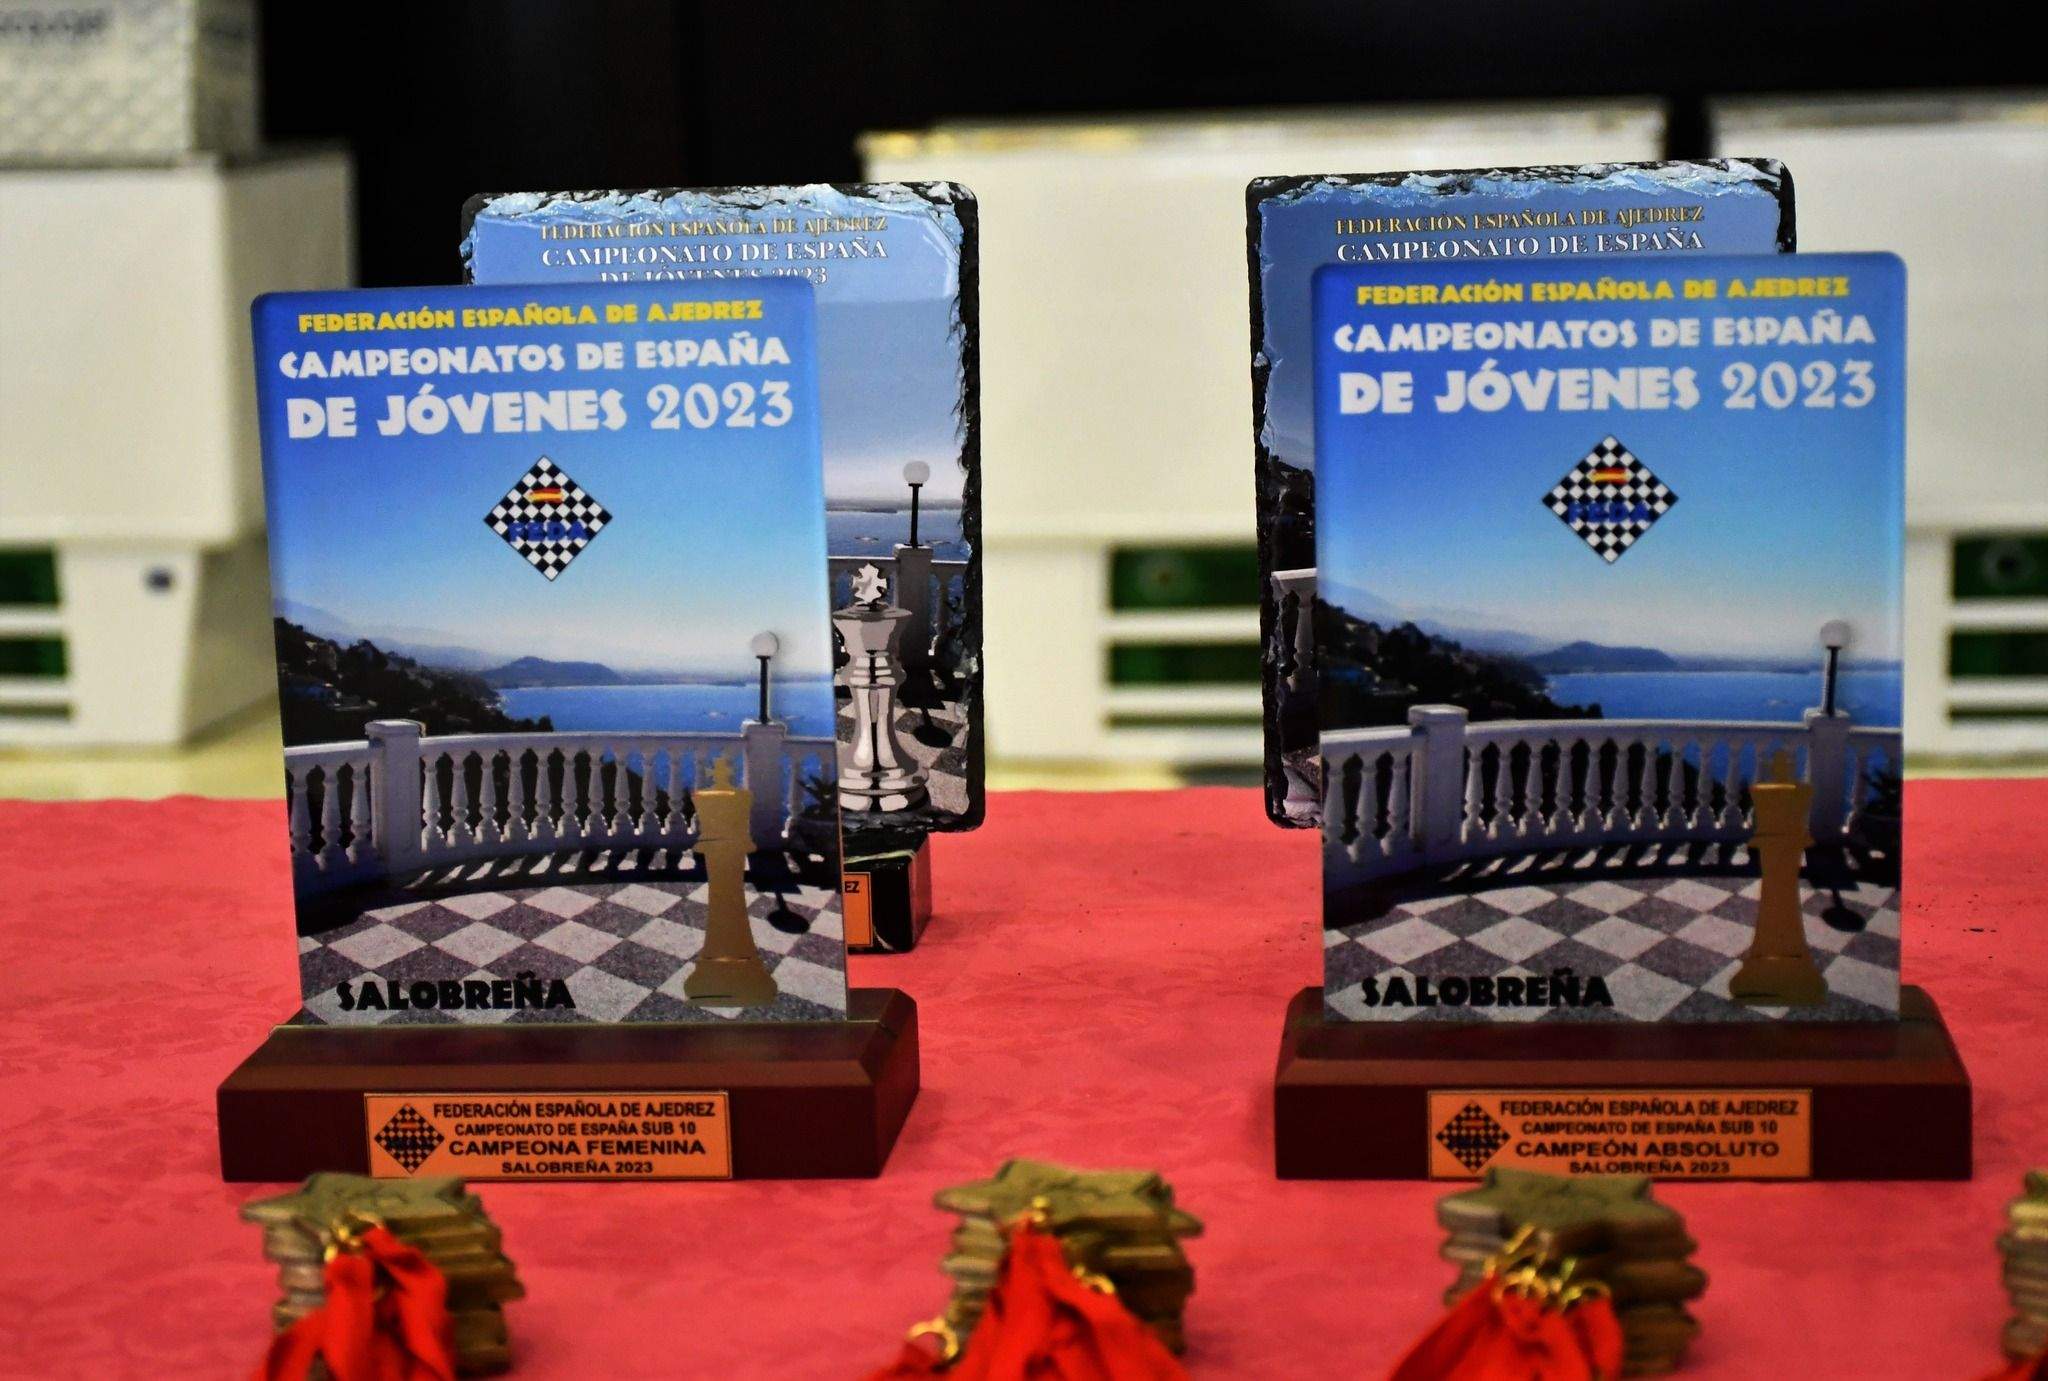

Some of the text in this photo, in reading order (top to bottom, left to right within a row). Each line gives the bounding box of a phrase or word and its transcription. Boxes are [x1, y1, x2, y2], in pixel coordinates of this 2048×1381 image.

[773, 217, 799, 234] DE
[803, 215, 888, 237] AJEDREZ
[1473, 209, 1577, 230] ESPAÑOLA
[1582, 208, 1611, 225] DE
[1615, 205, 1705, 228] AJEDREZ
[541, 235, 889, 266] CAMPEONATO DE ESPAÑA
[1337, 227, 1706, 262] CAMPEONATO DE ESPAÑA
[1356, 276, 1850, 307] FEDERACIÓN ESPAÑOLA DE AJEDREZ
[298, 299, 763, 333] FEDERACIÓN ESPAÑOLA DE AJEDREZ
[1333, 309, 1876, 354] CAMPEONATOS DE ESPAÑA
[279, 330, 792, 379] CAMPEONATOS DE ESPAÑA
[1339, 358, 1877, 415] DE JÓVENES 2023
[286, 379, 795, 439] DE JÓVENES 2023
[336, 971, 576, 1011] SALOBREÑA
[1362, 967, 1614, 1008] SALOBREÑA
[433, 1099, 715, 1118] FEDERACIÓN ESPAÑOLA DE AJEDREZ
[1500, 1097, 1800, 1117] FEDERACIÓN ESPAÑOLA DE AJEDREZ
[454, 1118, 696, 1136] CAMPEONATO DE ESPAÑA SUB 10
[1521, 1118, 1778, 1135] CAMPEONATO DE ESPAÑA SUB 10
[448, 1139, 581, 1157] CAMPEONA
[586, 1139, 707, 1156] FEMENINA
[1516, 1137, 1639, 1158] CAMPEÓN
[1644, 1140, 1780, 1158] ABSOLUTO
[501, 1158, 654, 1174] SALOBREÑA 2023
[1569, 1159, 1731, 1174] SALOBREÑA 2023
